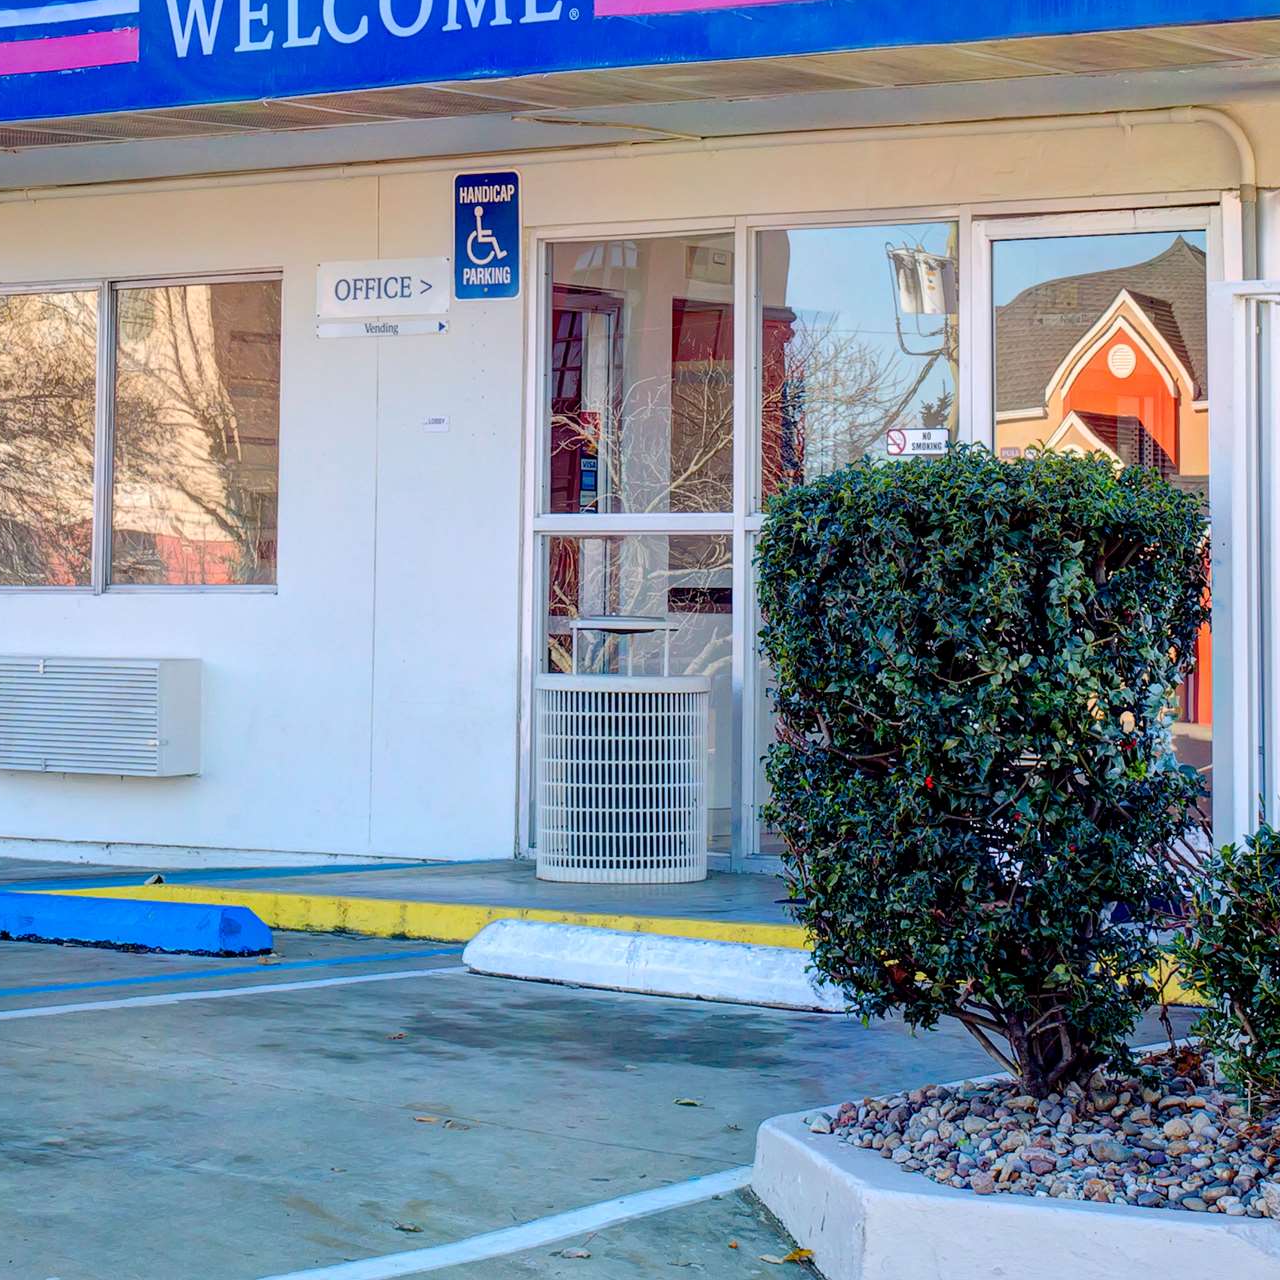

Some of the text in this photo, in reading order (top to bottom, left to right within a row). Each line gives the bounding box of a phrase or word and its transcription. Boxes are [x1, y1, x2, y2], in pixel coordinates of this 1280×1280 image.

[459, 184, 516, 204] HANDICAP
[462, 266, 512, 286] PARKING
[334, 276, 413, 302] OFFICE
[364, 322, 400, 336] Vending
[921, 431, 932, 441] NO
[911, 442, 943, 451] SMOKING
[582, 460, 597, 469] VISA
